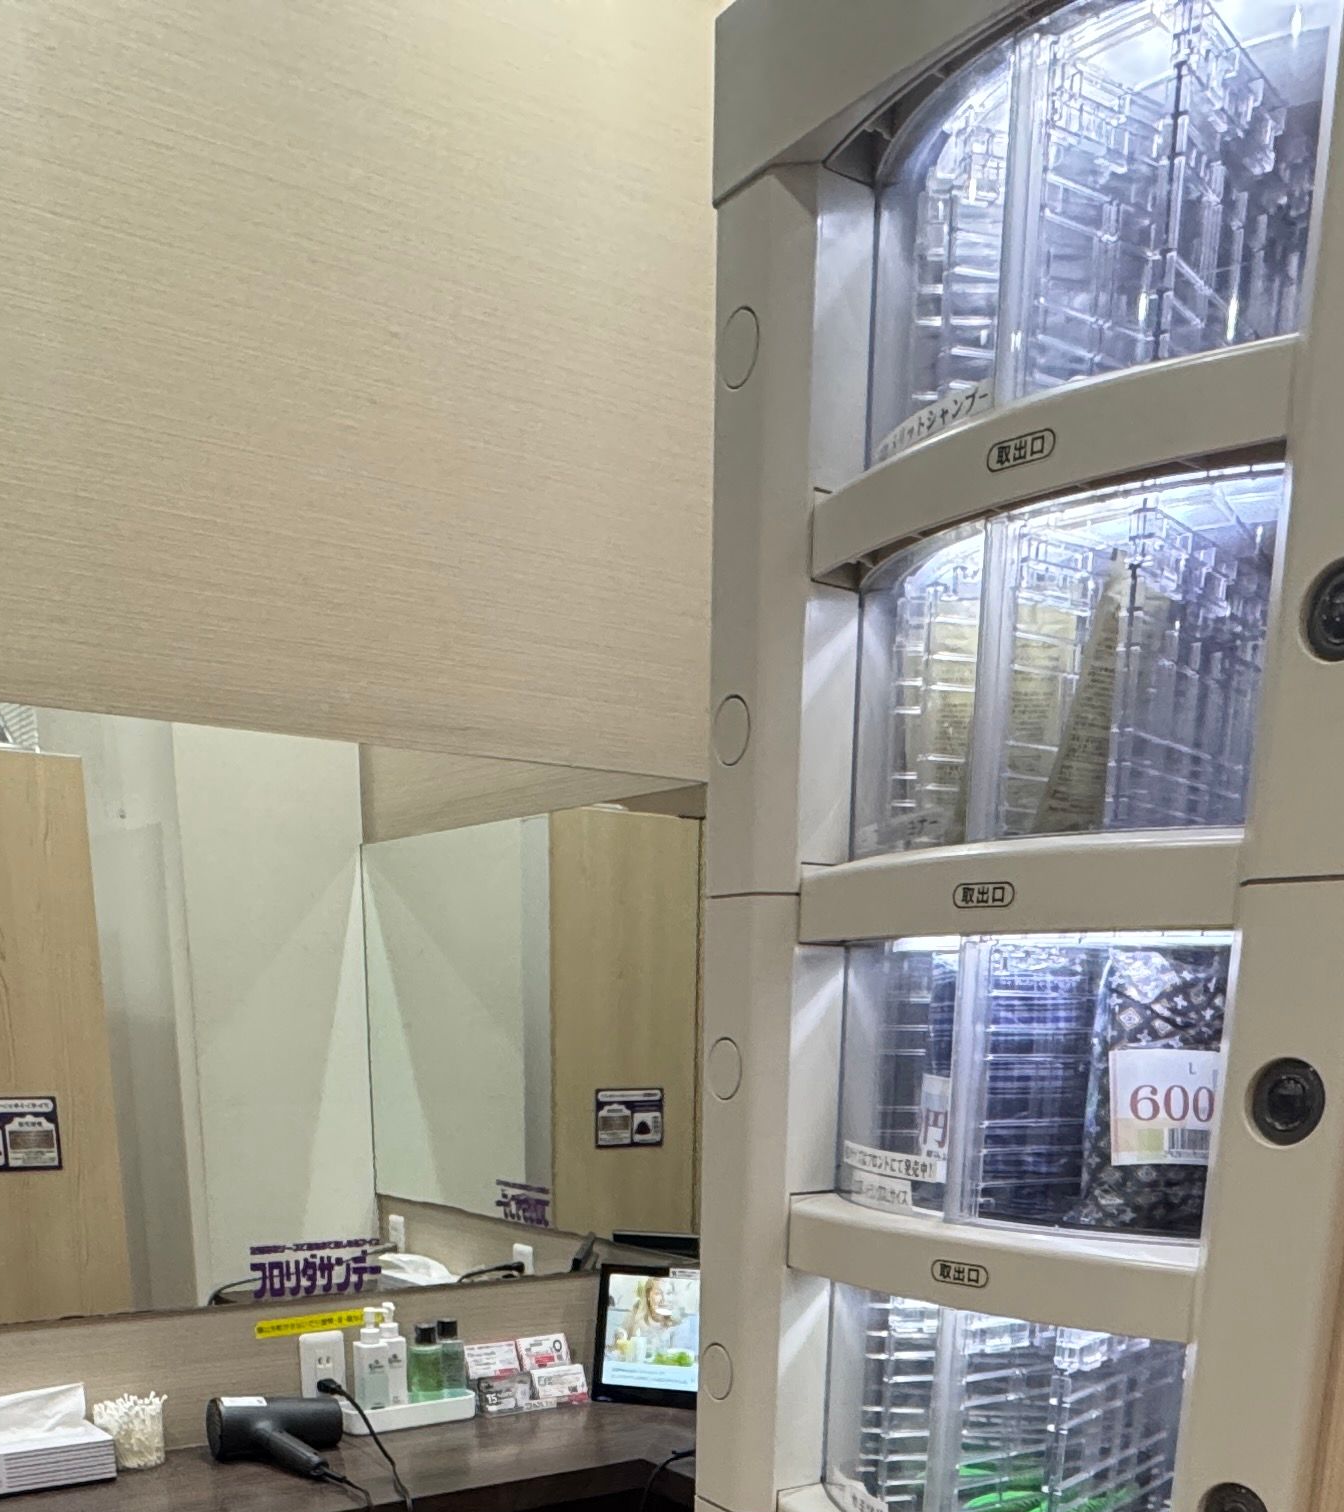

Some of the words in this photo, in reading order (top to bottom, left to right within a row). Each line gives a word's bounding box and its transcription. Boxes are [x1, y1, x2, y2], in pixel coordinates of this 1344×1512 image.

[996, 436, 1046, 465] 取出口
[961, 885, 1006, 905] 取出口
[1129, 1084, 1216, 1123] 600
[250, 1250, 382, 1299] フロリダサンデー
[938, 1263, 980, 1285] 取出口
